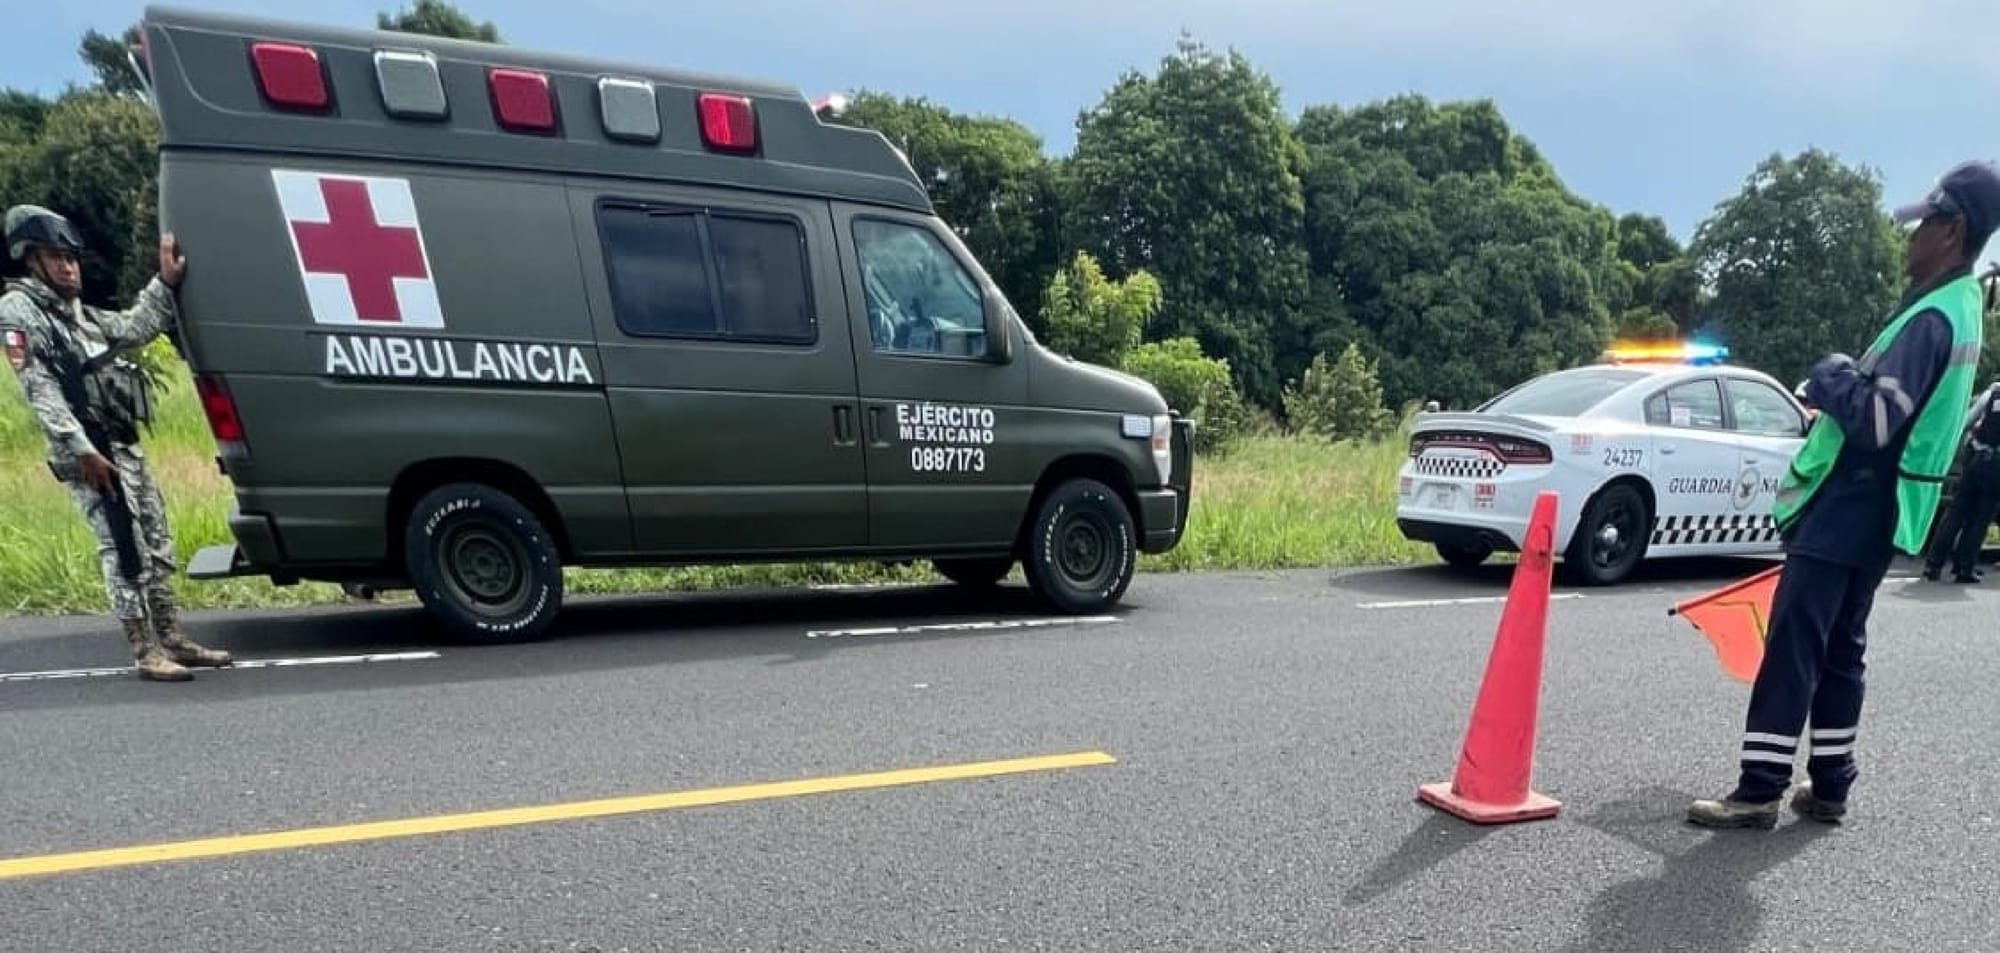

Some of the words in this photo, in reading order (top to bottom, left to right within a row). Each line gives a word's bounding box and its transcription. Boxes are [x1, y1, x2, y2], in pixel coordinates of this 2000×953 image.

[326, 335, 594, 384] AMBULANCIA
[896, 401, 995, 428] EJÉRCITO
[899, 426, 995, 444] MEXICANO
[911, 446, 986, 472] 0887173
[1603, 447, 1643, 467] 24237
[1668, 477, 1733, 494] GUARDIA
